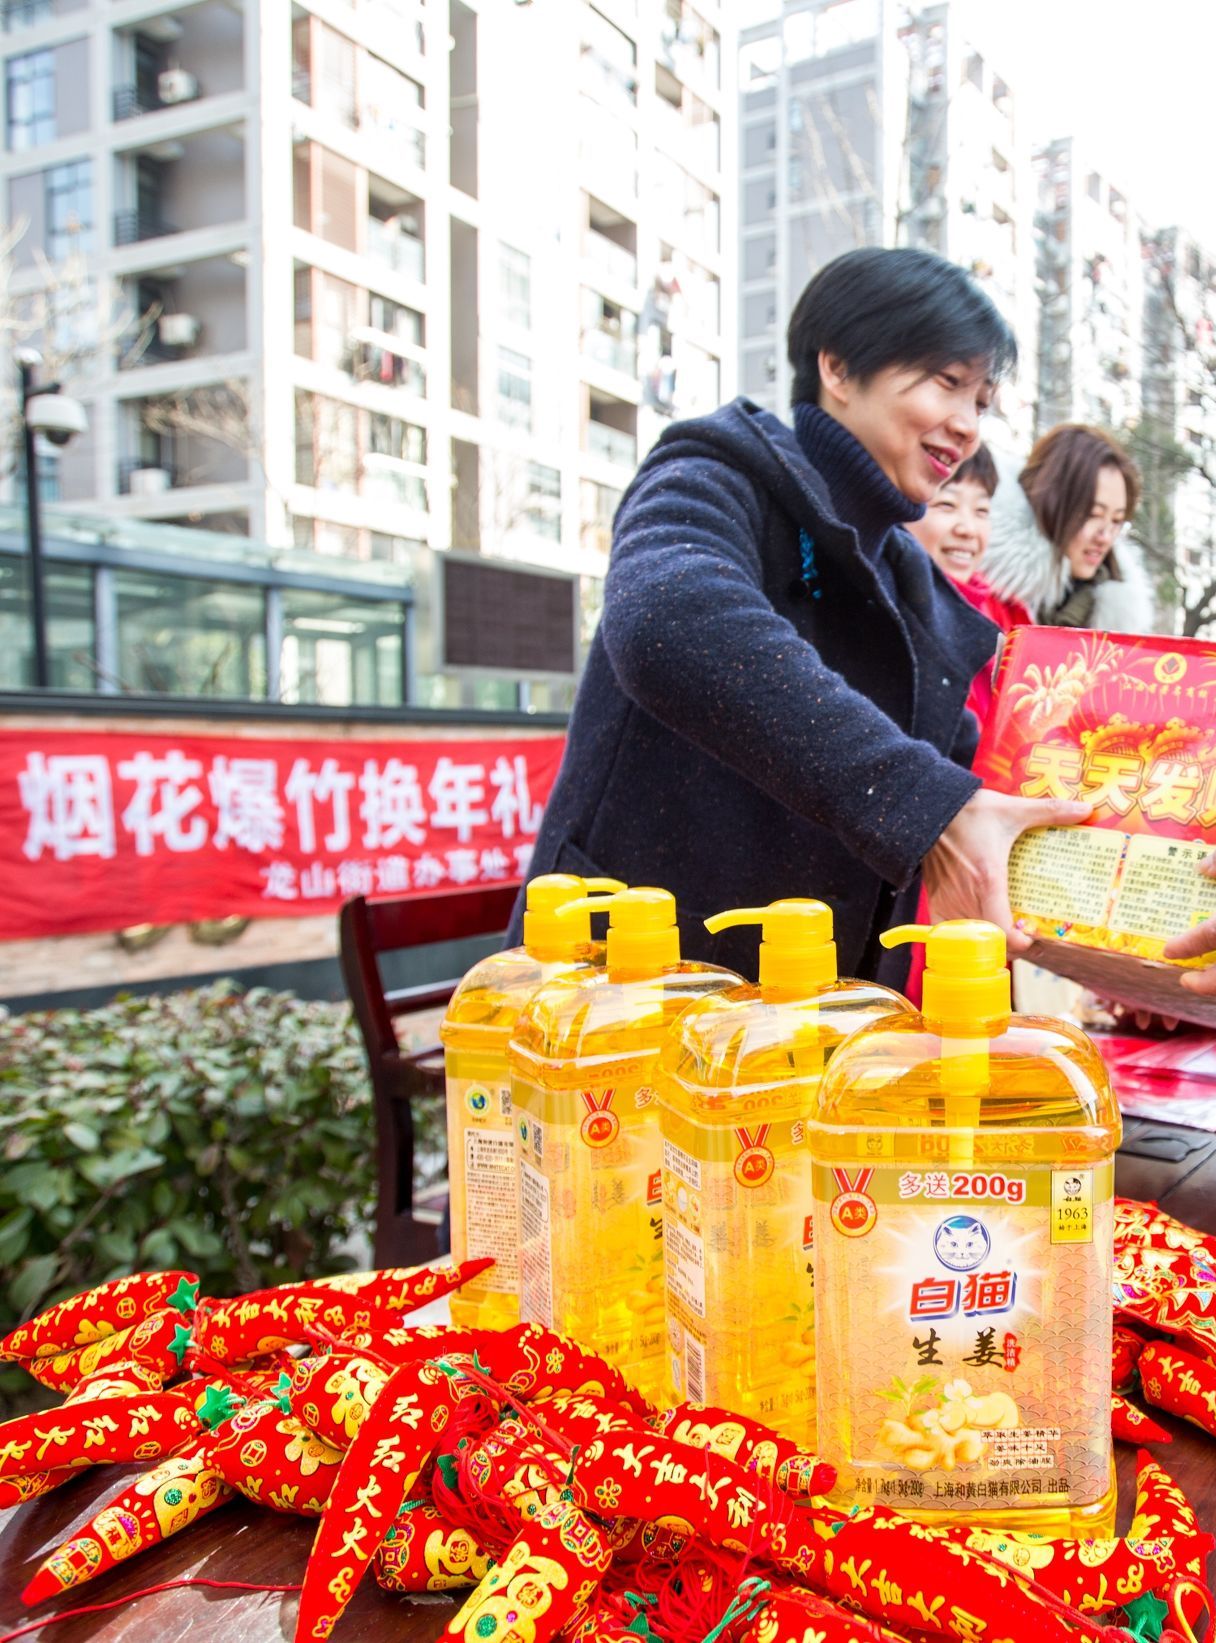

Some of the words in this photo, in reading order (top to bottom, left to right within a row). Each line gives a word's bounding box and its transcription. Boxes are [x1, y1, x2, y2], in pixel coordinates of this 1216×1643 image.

[19, 751, 543, 860] 烟花爆竹换年礼
[899, 1171, 1025, 1205] 多送200g
[841, 1206, 867, 1221] A类
[1058, 1207, 1088, 1221] 1963
[211, 1295, 323, 1328] 大吉大利
[909, 1271, 1017, 1322] 白猫
[911, 1326, 1004, 1369] 生姜
[331, 1393, 424, 1561] 红红火火
[612, 1443, 767, 1529] 大吉大利
[1047, 1477, 1071, 1494] 出品
[840, 1556, 988, 1642] 大吉大利
